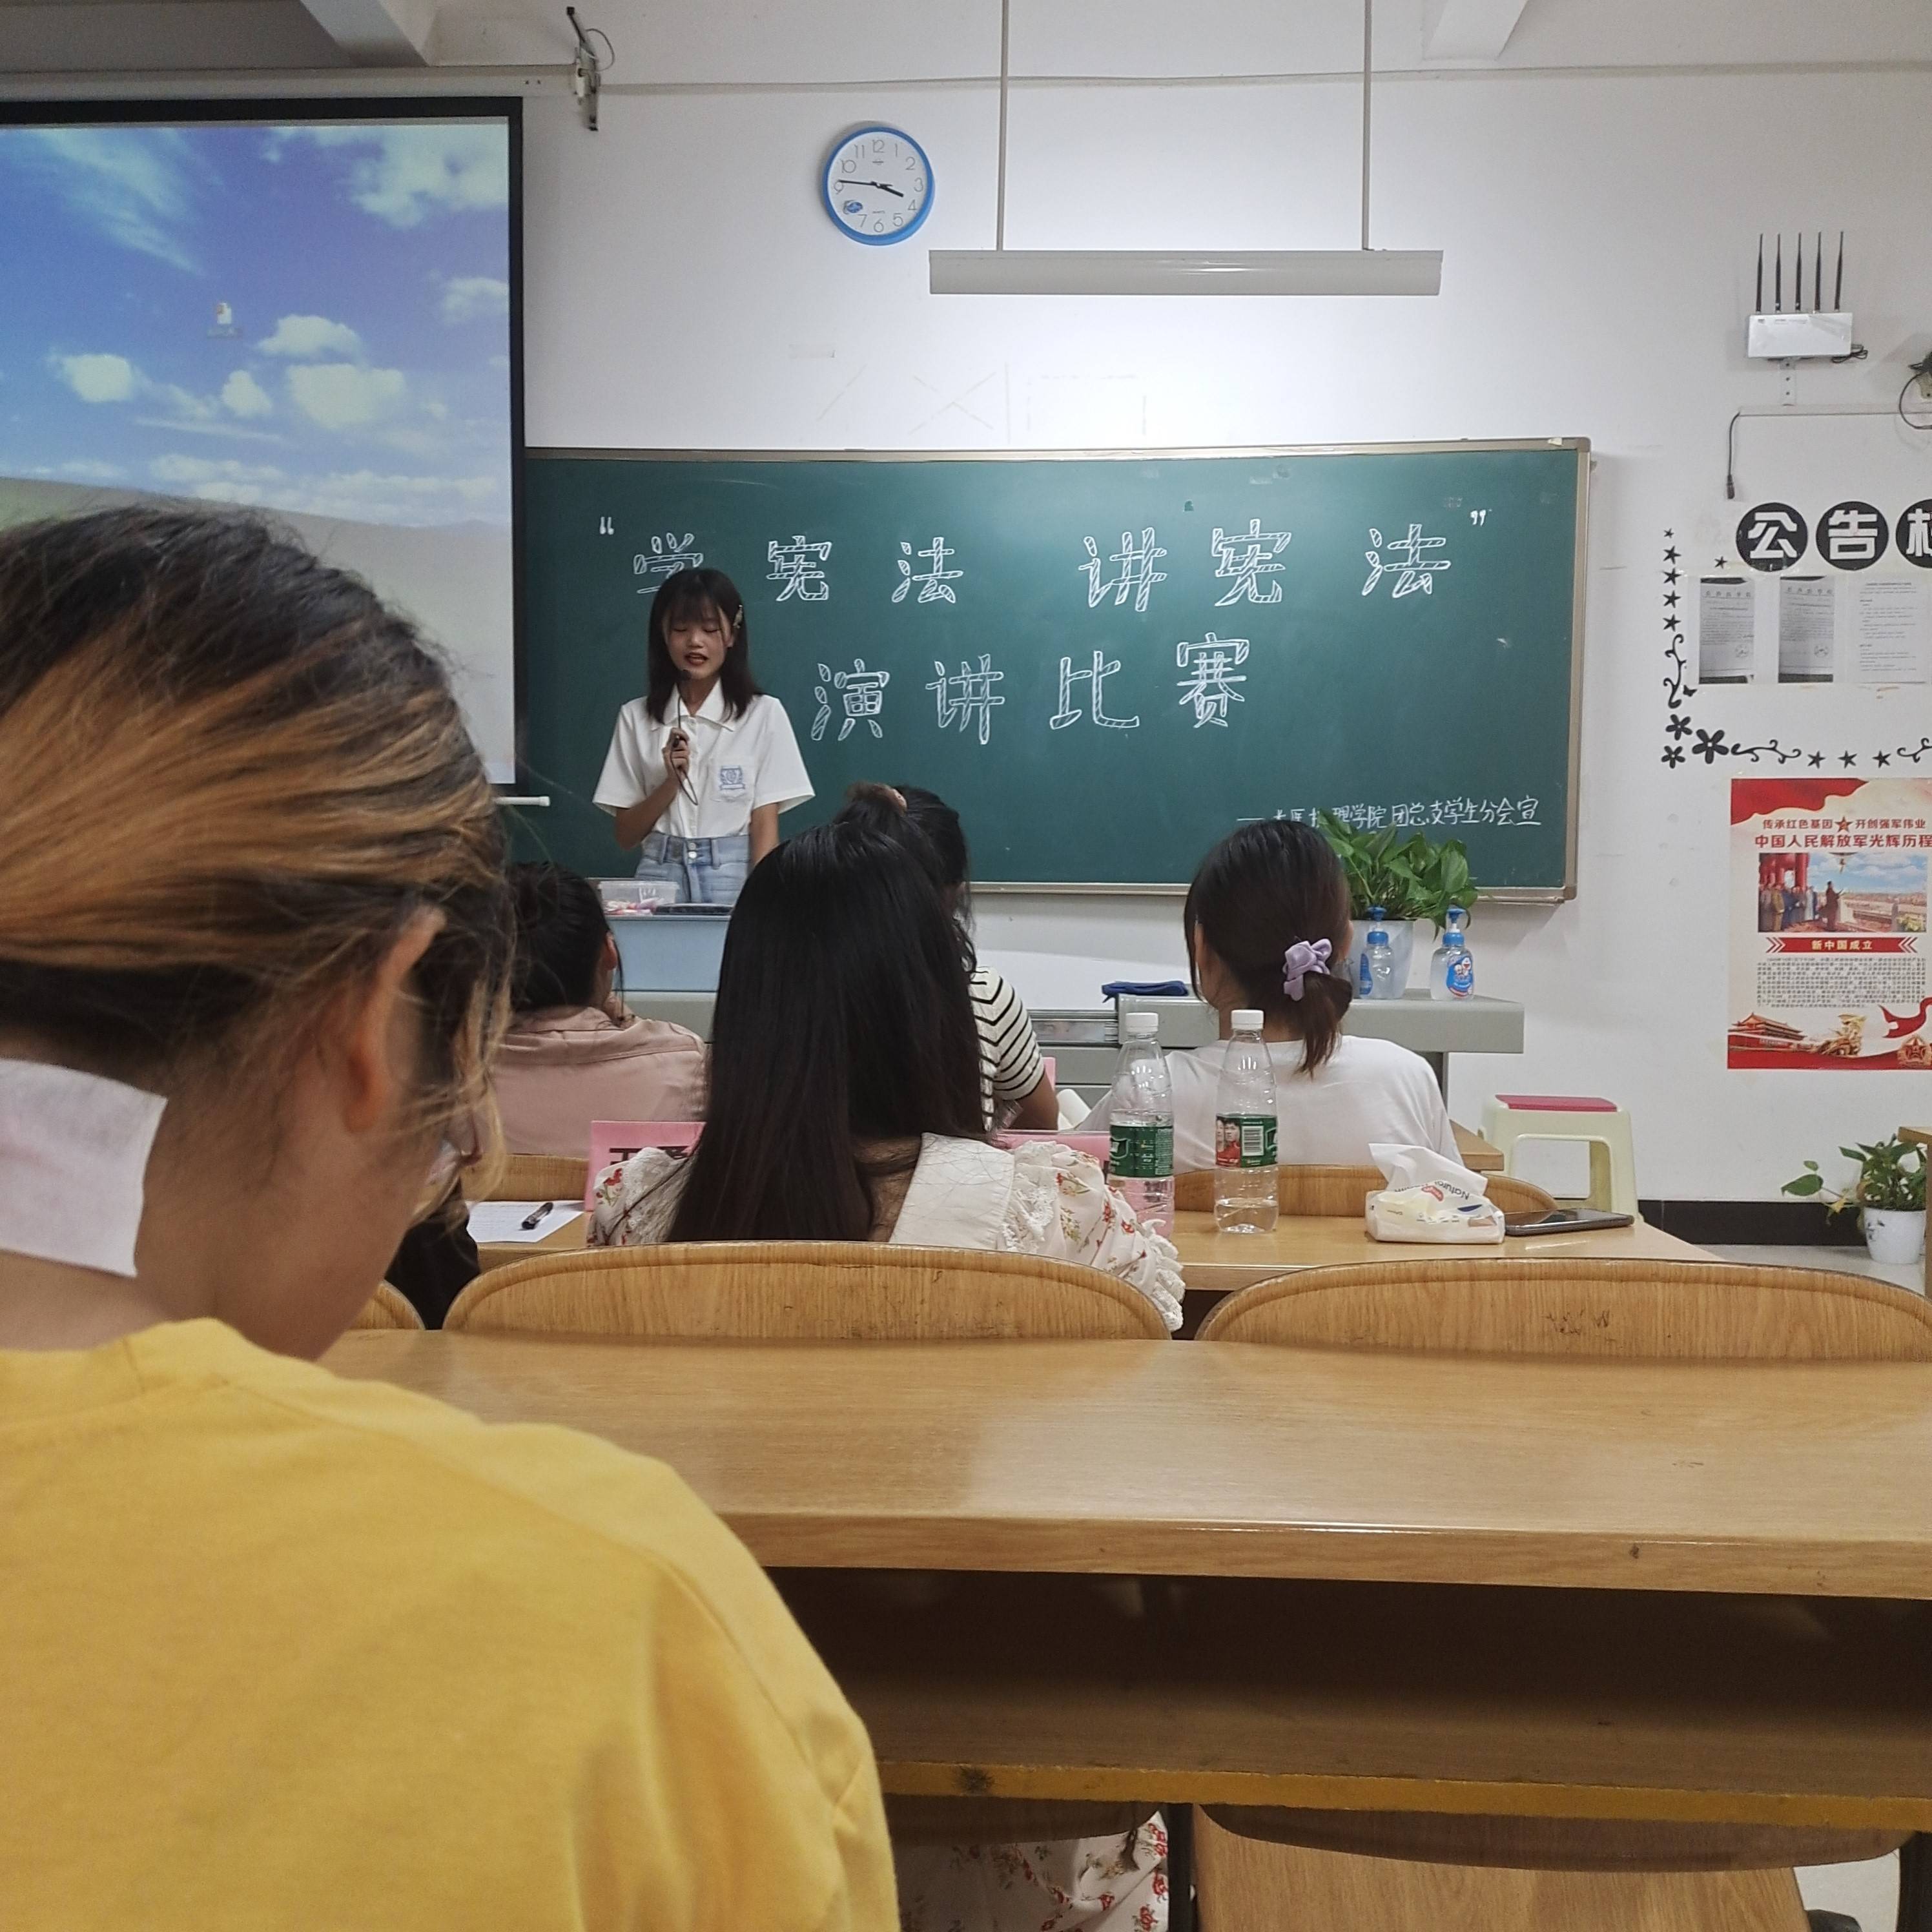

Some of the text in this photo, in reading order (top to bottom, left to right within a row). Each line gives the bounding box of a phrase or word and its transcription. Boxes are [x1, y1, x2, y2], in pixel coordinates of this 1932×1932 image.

[854, 145, 865, 158] 11
[872, 139, 885, 153] 12
[841, 159, 857, 173] 10
[905, 156, 916, 170] 2
[834, 180, 844, 194] 9
[914, 178, 923, 192] 3
[907, 199, 918, 211] 4
[858, 214, 868, 227] 7
[874, 218, 884, 232] 6
[893, 213, 903, 227] 5
[810, 632, 1251, 745] 演讲比赛
[1763, 819, 1926, 830] 传承红色基因 开创强军伟业
[1754, 834, 1932, 848] 中国人民解放军光辉历程
[1811, 940, 1873, 951] 新中国成立
